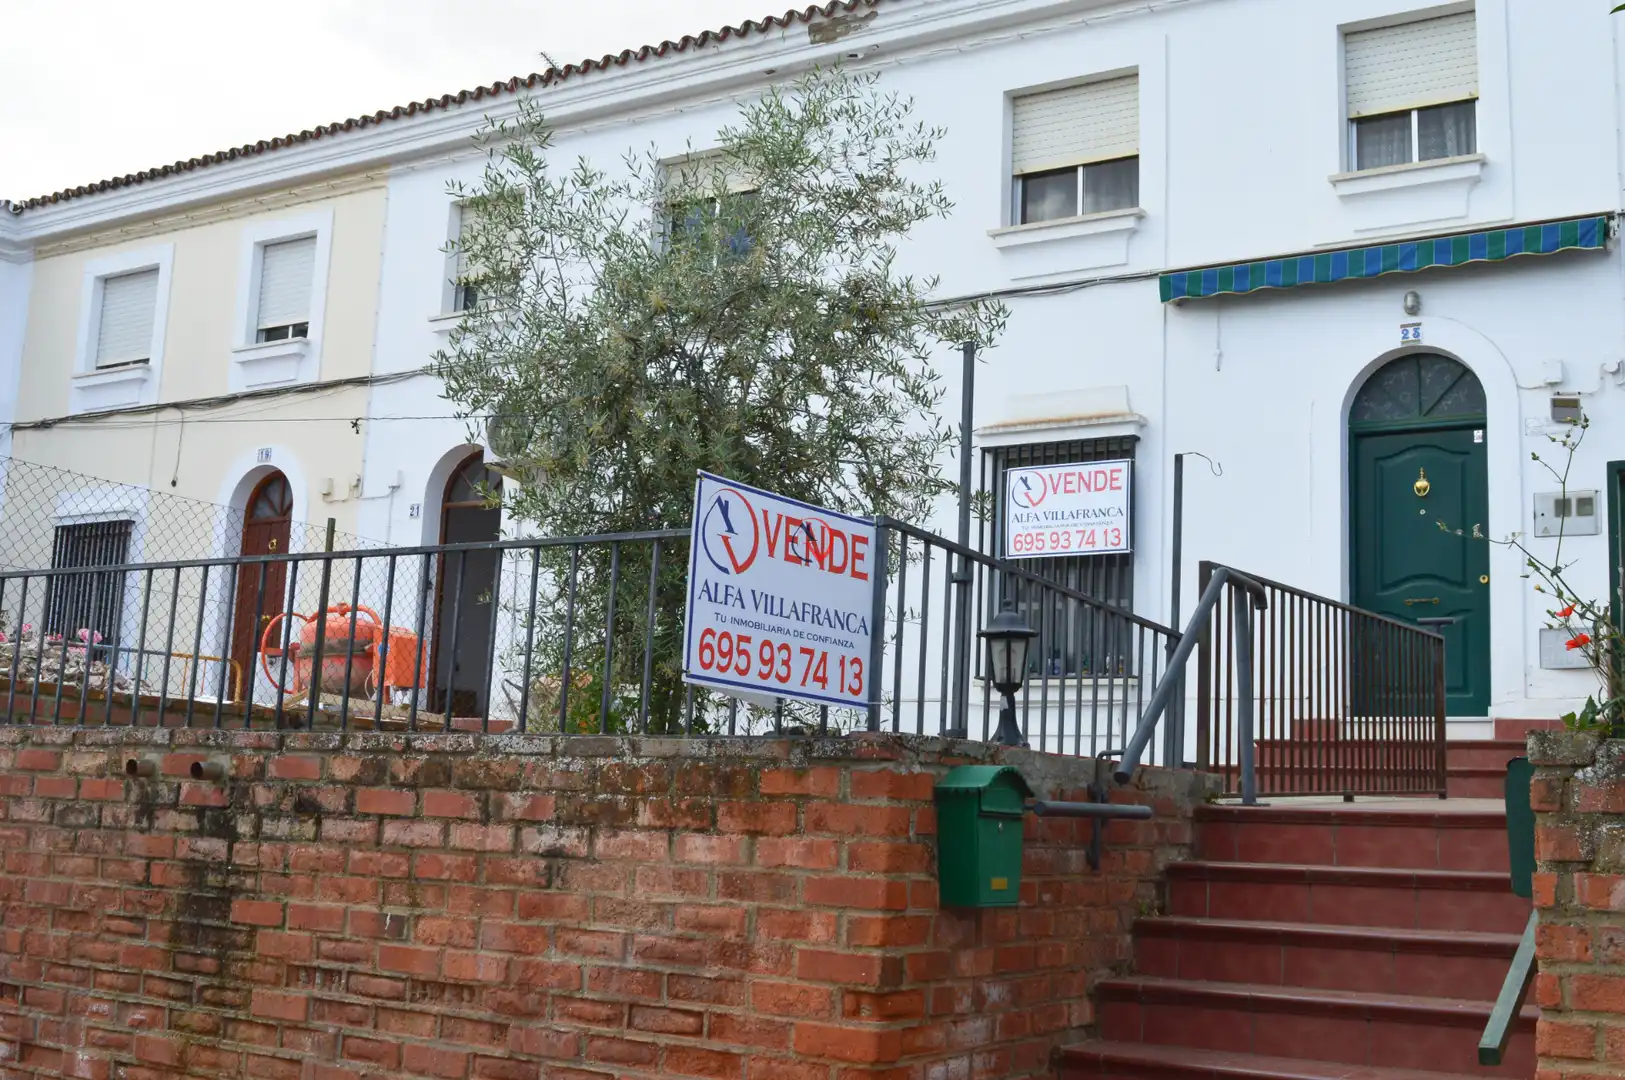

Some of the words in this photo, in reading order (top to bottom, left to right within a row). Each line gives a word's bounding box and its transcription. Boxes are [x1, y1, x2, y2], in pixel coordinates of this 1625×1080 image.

[1049, 468, 1122, 495] VENDE
[410, 505, 420, 516] 21
[1012, 512, 1040, 523] ALFA
[1043, 506, 1124, 521] VILLAFRANCA
[761, 508, 869, 581] VENDE
[1013, 531, 1045, 552] 695
[1050, 530, 1071, 550] 93
[1076, 529, 1096, 548] 74
[1103, 527, 1121, 547] 13
[698, 579, 745, 610] ALFA
[751, 589, 869, 636] VILLAFRANCA
[714, 612, 727, 623] TU
[730, 616, 791, 636] INMOBILIARIA
[793, 629, 804, 639] DE
[806, 632, 855, 649] CONFIANZA
[699, 627, 752, 677] 695
[757, 639, 792, 684] 93
[800, 646, 828, 690] 74
[839, 654, 863, 696] 13
